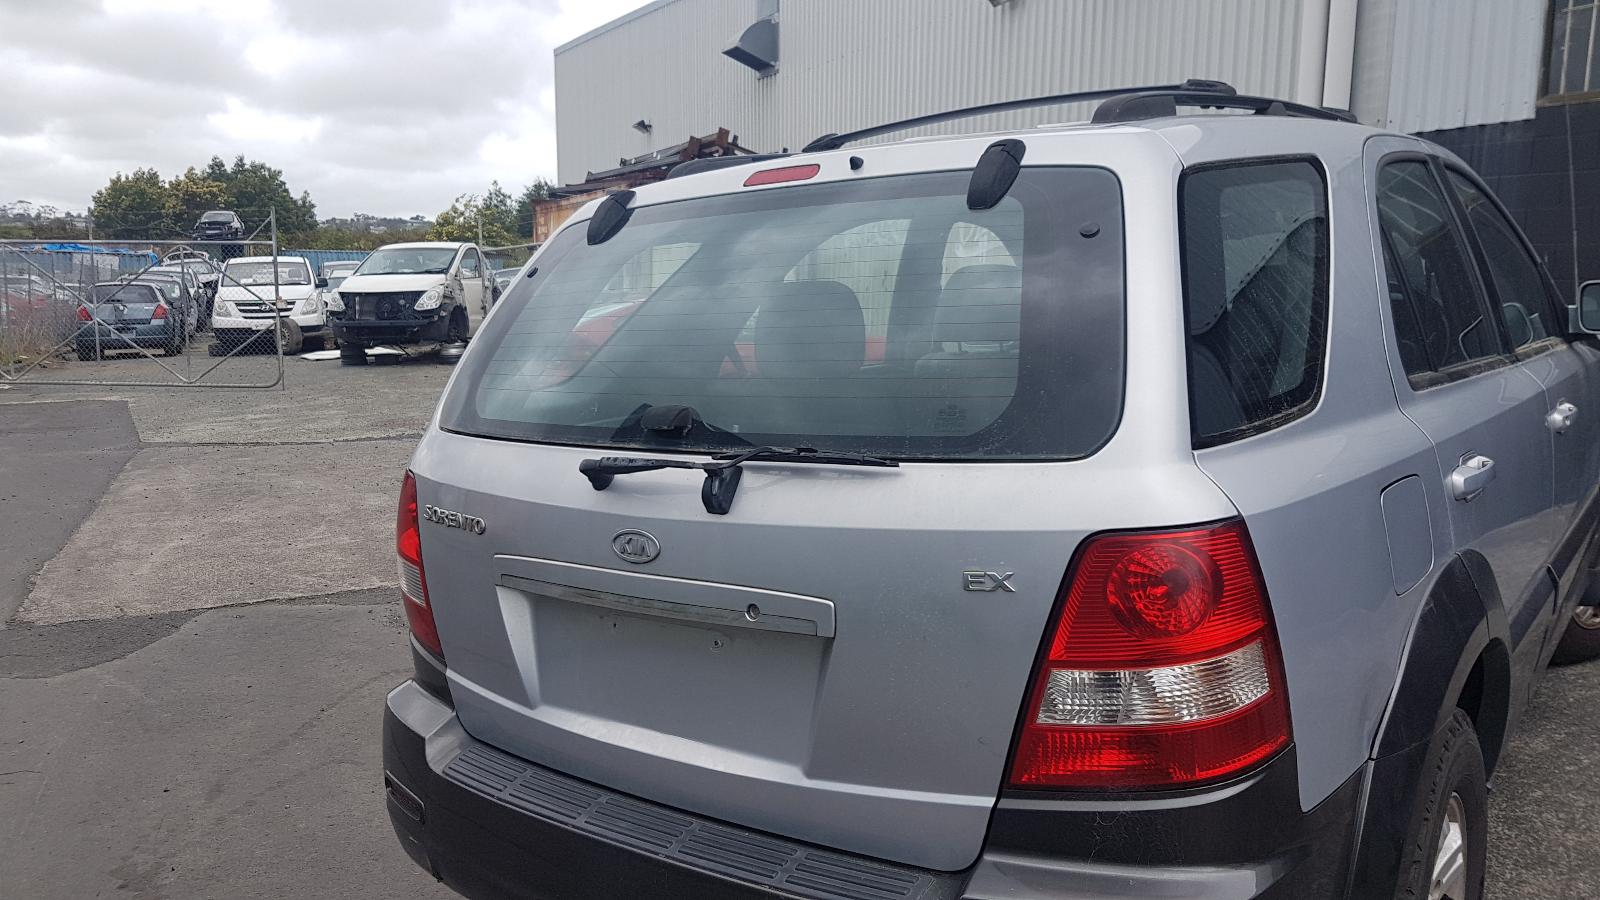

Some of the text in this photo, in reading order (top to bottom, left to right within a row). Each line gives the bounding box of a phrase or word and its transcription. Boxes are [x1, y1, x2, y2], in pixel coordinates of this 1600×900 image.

[423, 504, 486, 535] SORENTO
[619, 536, 651, 558] KIA
[963, 571, 1016, 592] EX
